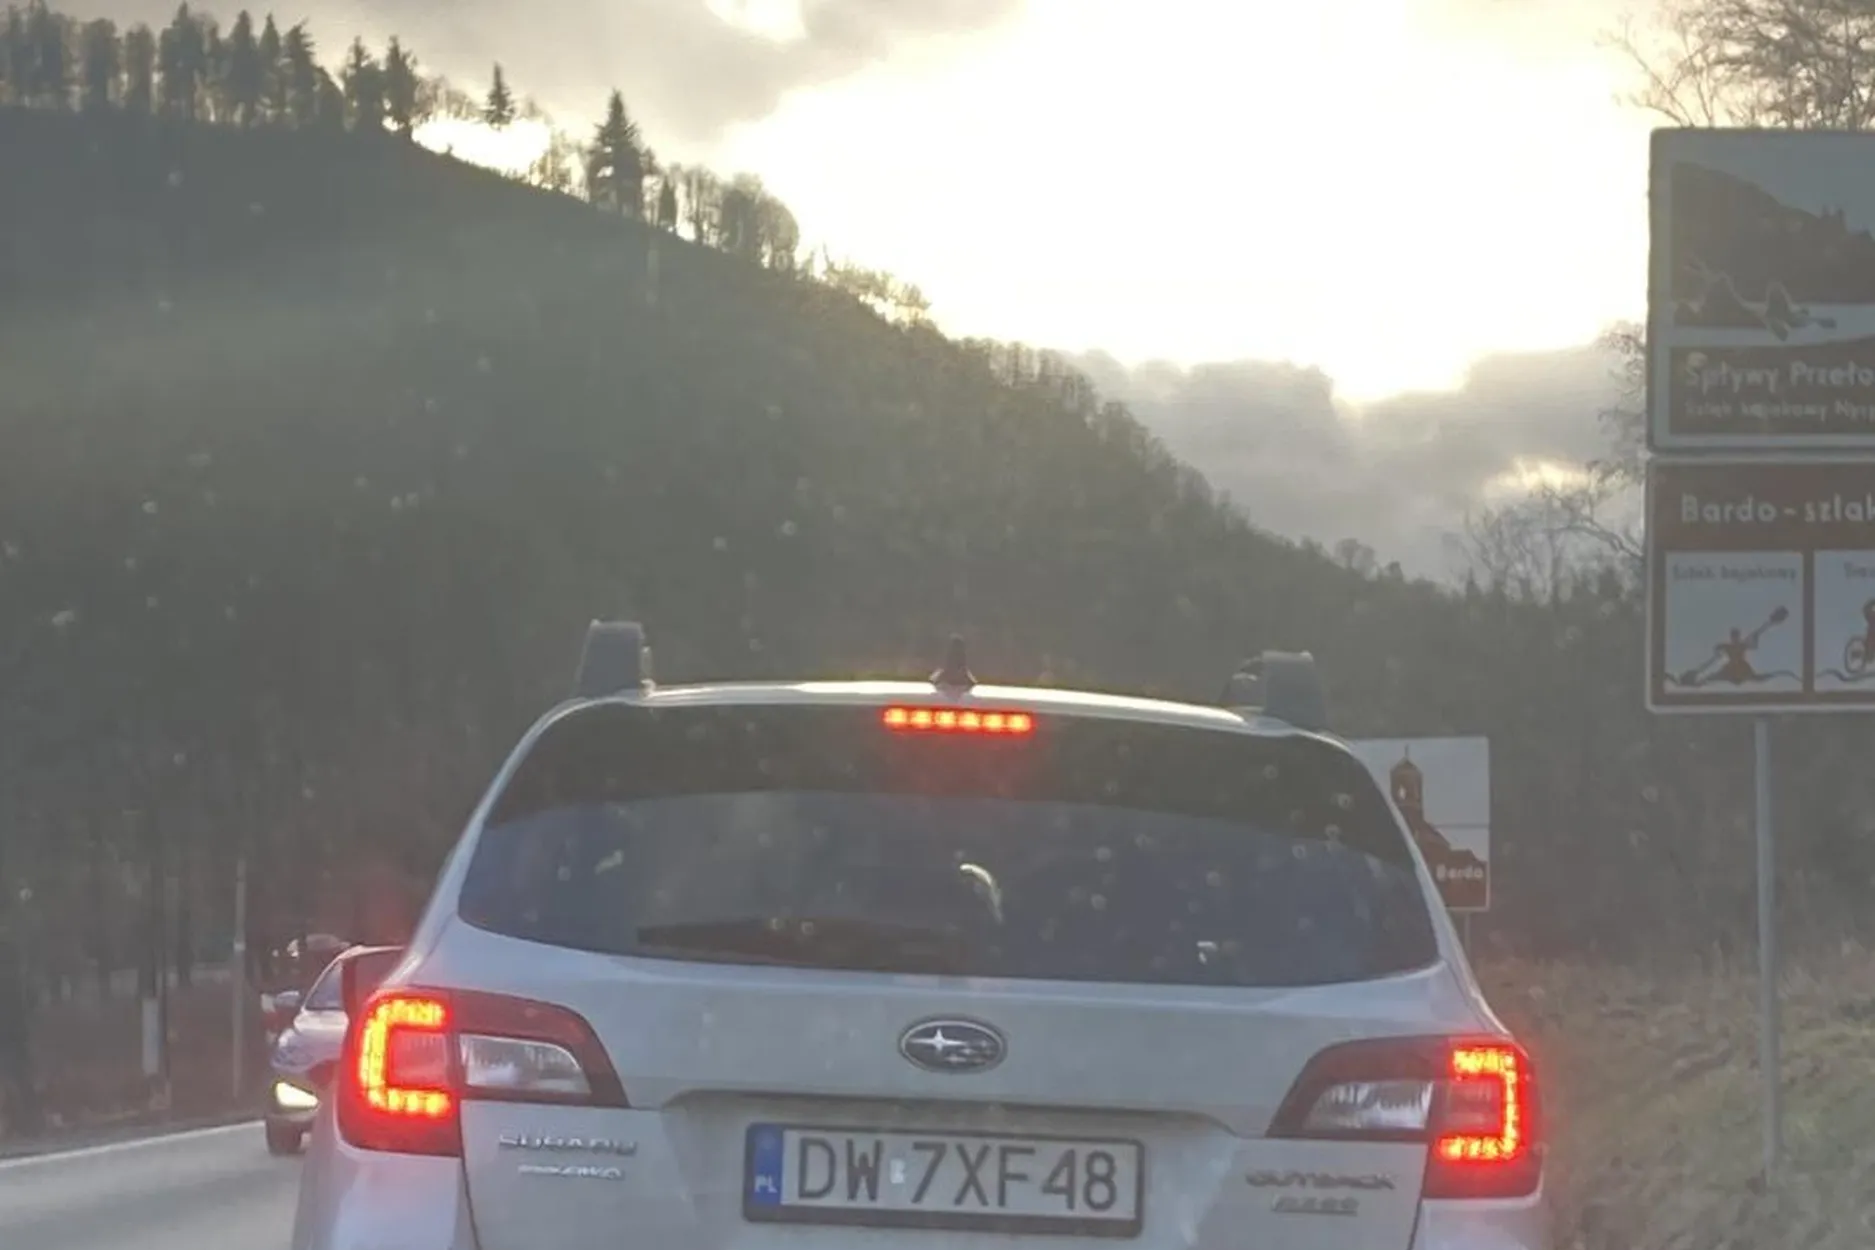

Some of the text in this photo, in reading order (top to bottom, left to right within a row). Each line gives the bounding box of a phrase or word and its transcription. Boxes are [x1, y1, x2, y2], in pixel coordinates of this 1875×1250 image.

[1436, 864, 1484, 881] Bardo
[797, 1136, 1118, 1212] DW 7XF48
[754, 1175, 777, 1193] PL
